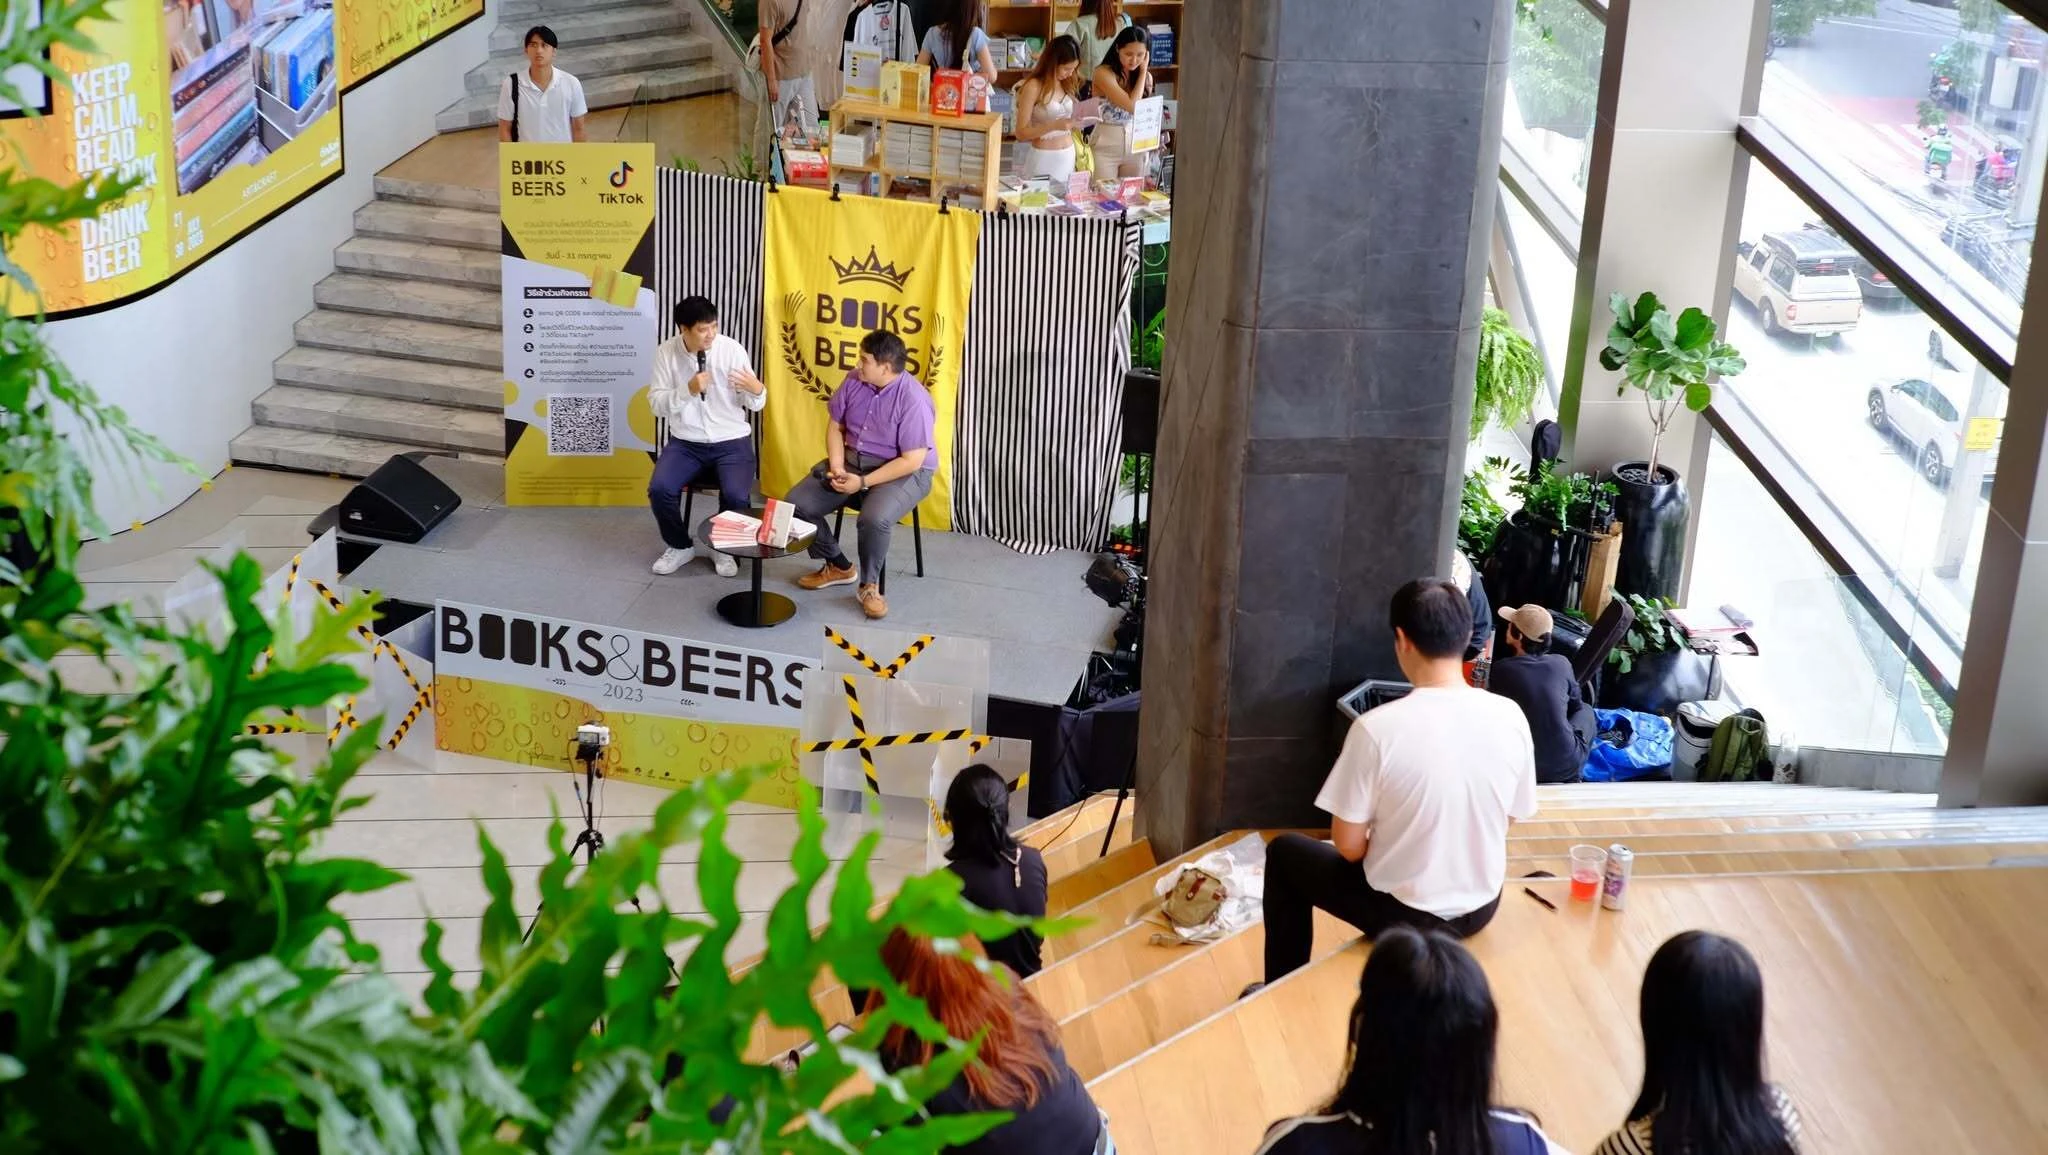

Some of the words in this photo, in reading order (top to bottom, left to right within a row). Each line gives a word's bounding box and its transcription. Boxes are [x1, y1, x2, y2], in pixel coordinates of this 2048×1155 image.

[72, 62, 130, 107] KEEP
[74, 93, 145, 139] CALM,
[76, 128, 137, 174] READ
[511, 160, 566, 176] BOOKS
[511, 181, 566, 196] BEERS
[80, 200, 150, 251] DRINK
[83, 237, 142, 283] BEER
[816, 293, 923, 336] BOOKS
[814, 336, 921, 376] BES
[603, 682, 644, 702] 2023
